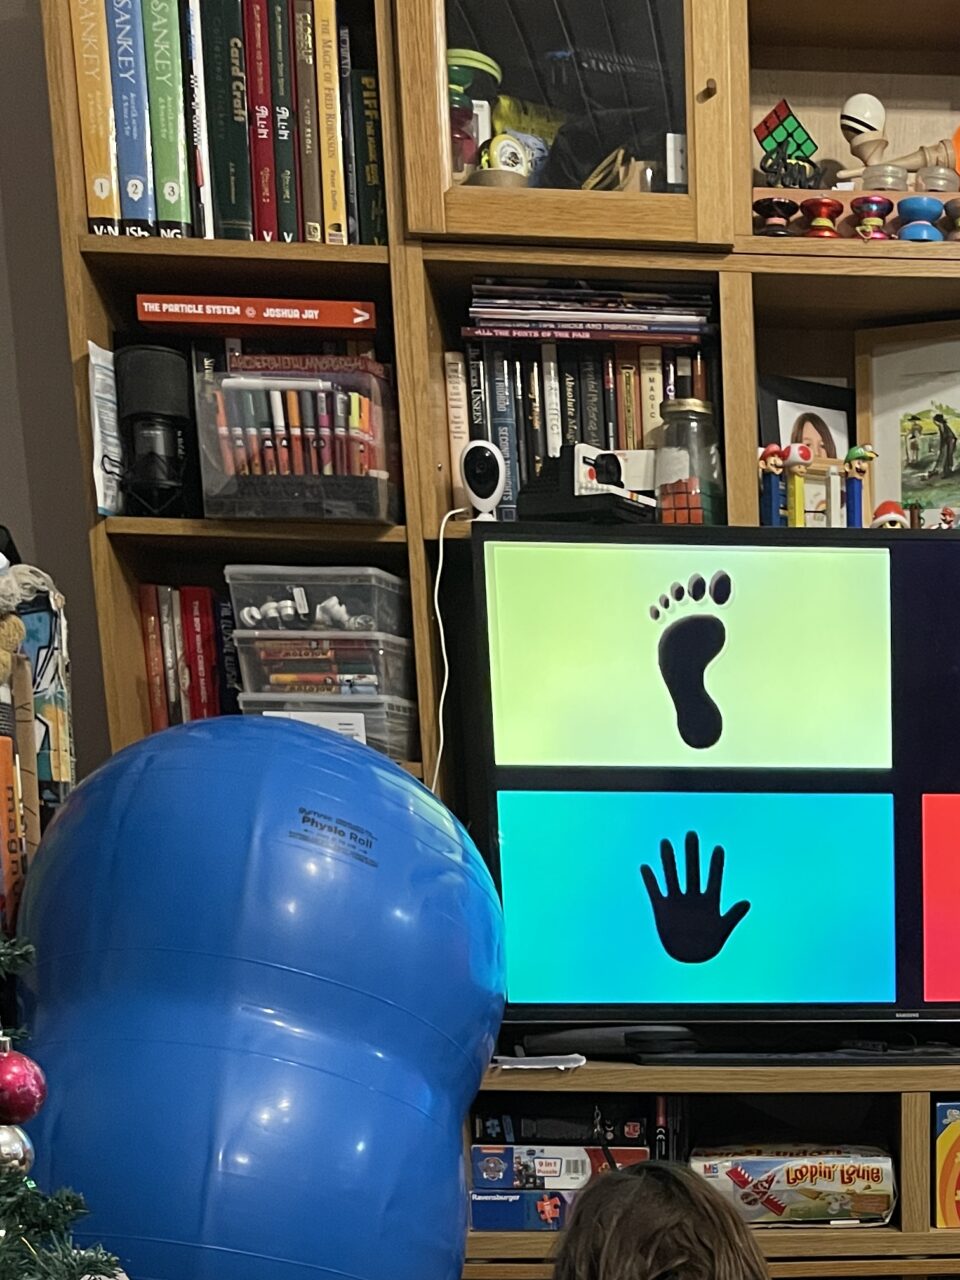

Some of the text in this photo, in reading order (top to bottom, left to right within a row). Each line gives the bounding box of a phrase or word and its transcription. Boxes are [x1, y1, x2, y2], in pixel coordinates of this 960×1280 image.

[113, 0, 136, 84] SANKEY
[151, 0, 173, 87] SANKEY
[322, 39, 333, 69] MAGIC
[230, 38, 246, 122] Card Craft
[324, 87, 336, 109] FRED
[361, 76, 378, 118] PIFF
[325, 114, 335, 158] ROBINSON
[99, 182, 104, 193] 1
[131, 183, 139, 195] 2
[168, 185, 176, 197] 3
[143, 302, 241, 315] THE PARTICLE SYSTEM
[263, 308, 319, 320] JOSHUA JAY
[471, 388, 483, 424] UNSEEN
[565, 374, 576, 416] Absolute
[499, 426, 510, 459] SECOND
[301, 815, 373, 849] Physio Roll
[703, 1164, 719, 1174] MB
[785, 1161, 883, 1186] Loopin' Louie
[471, 1193, 520, 1202] Ravensburger
